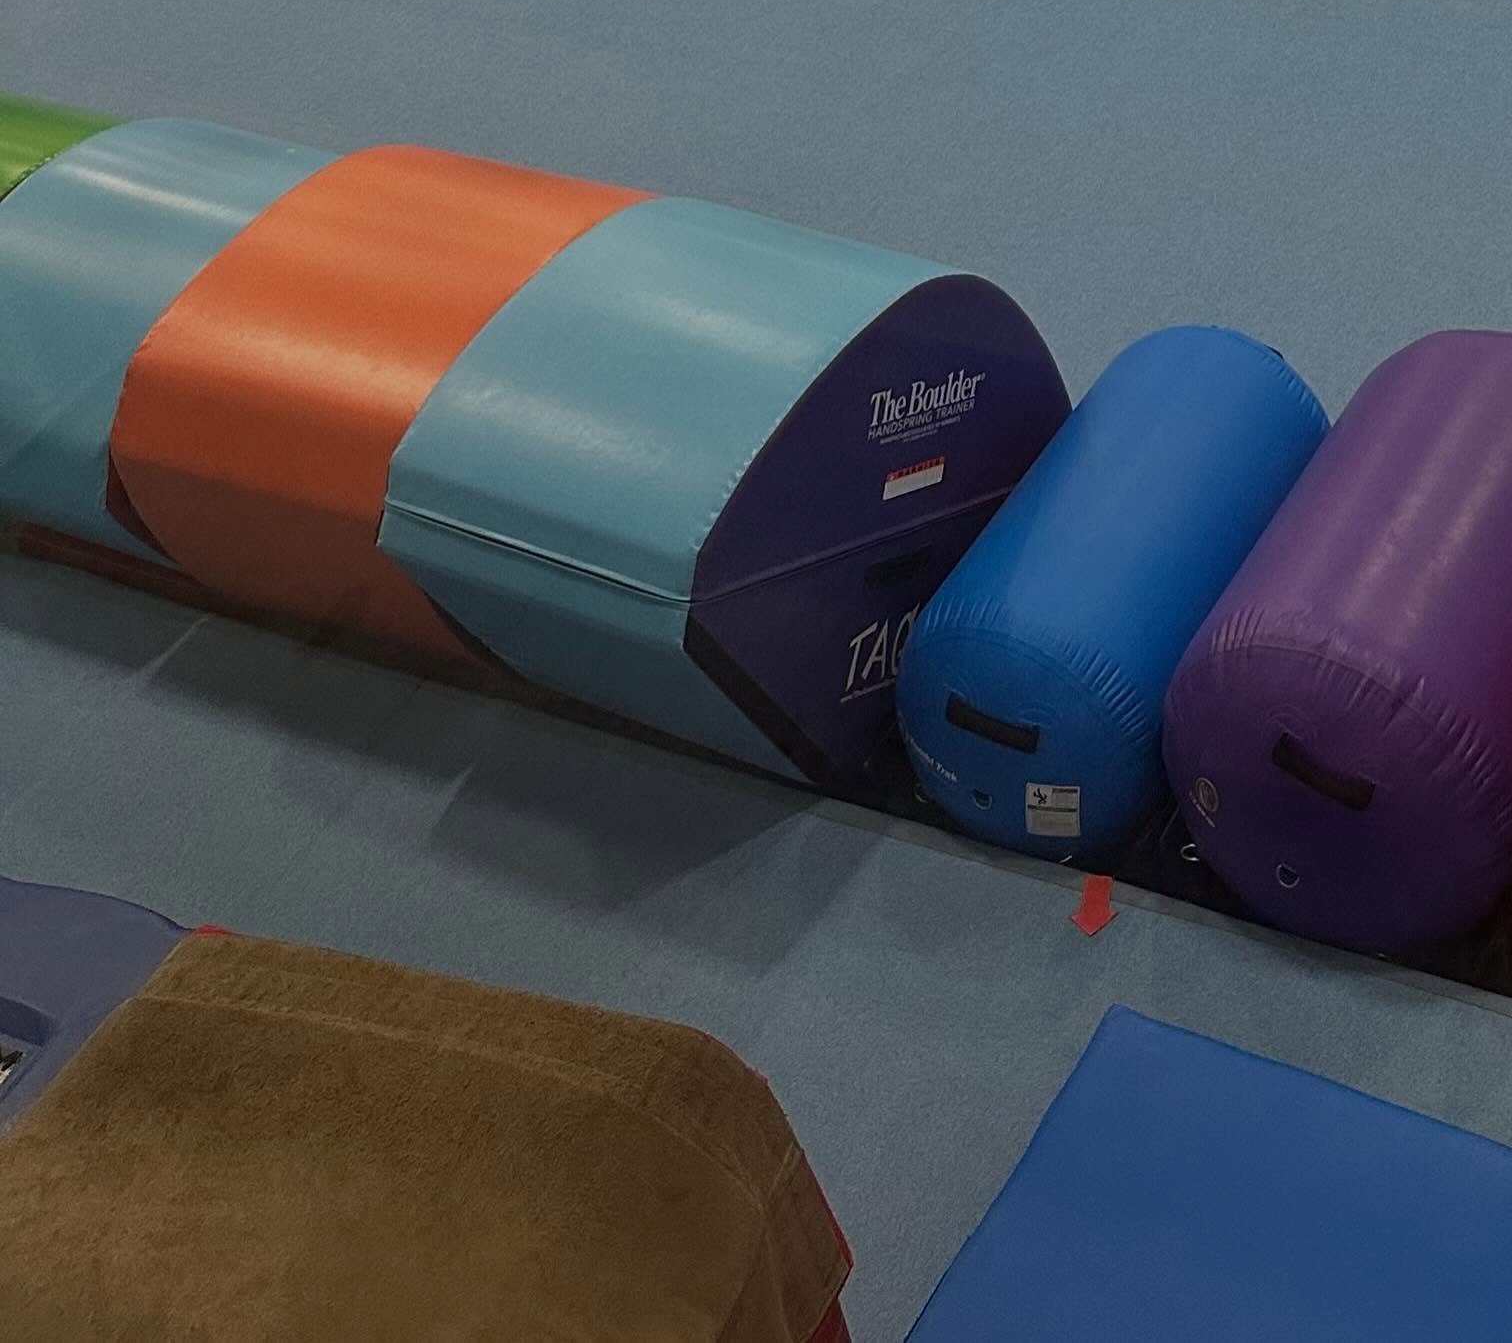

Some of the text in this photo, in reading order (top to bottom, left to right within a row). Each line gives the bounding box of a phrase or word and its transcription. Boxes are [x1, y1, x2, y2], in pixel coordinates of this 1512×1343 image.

[867, 409, 934, 441] HANDSPRING
[935, 397, 976, 421] TRAINER
[869, 369, 981, 428] The Boulder
